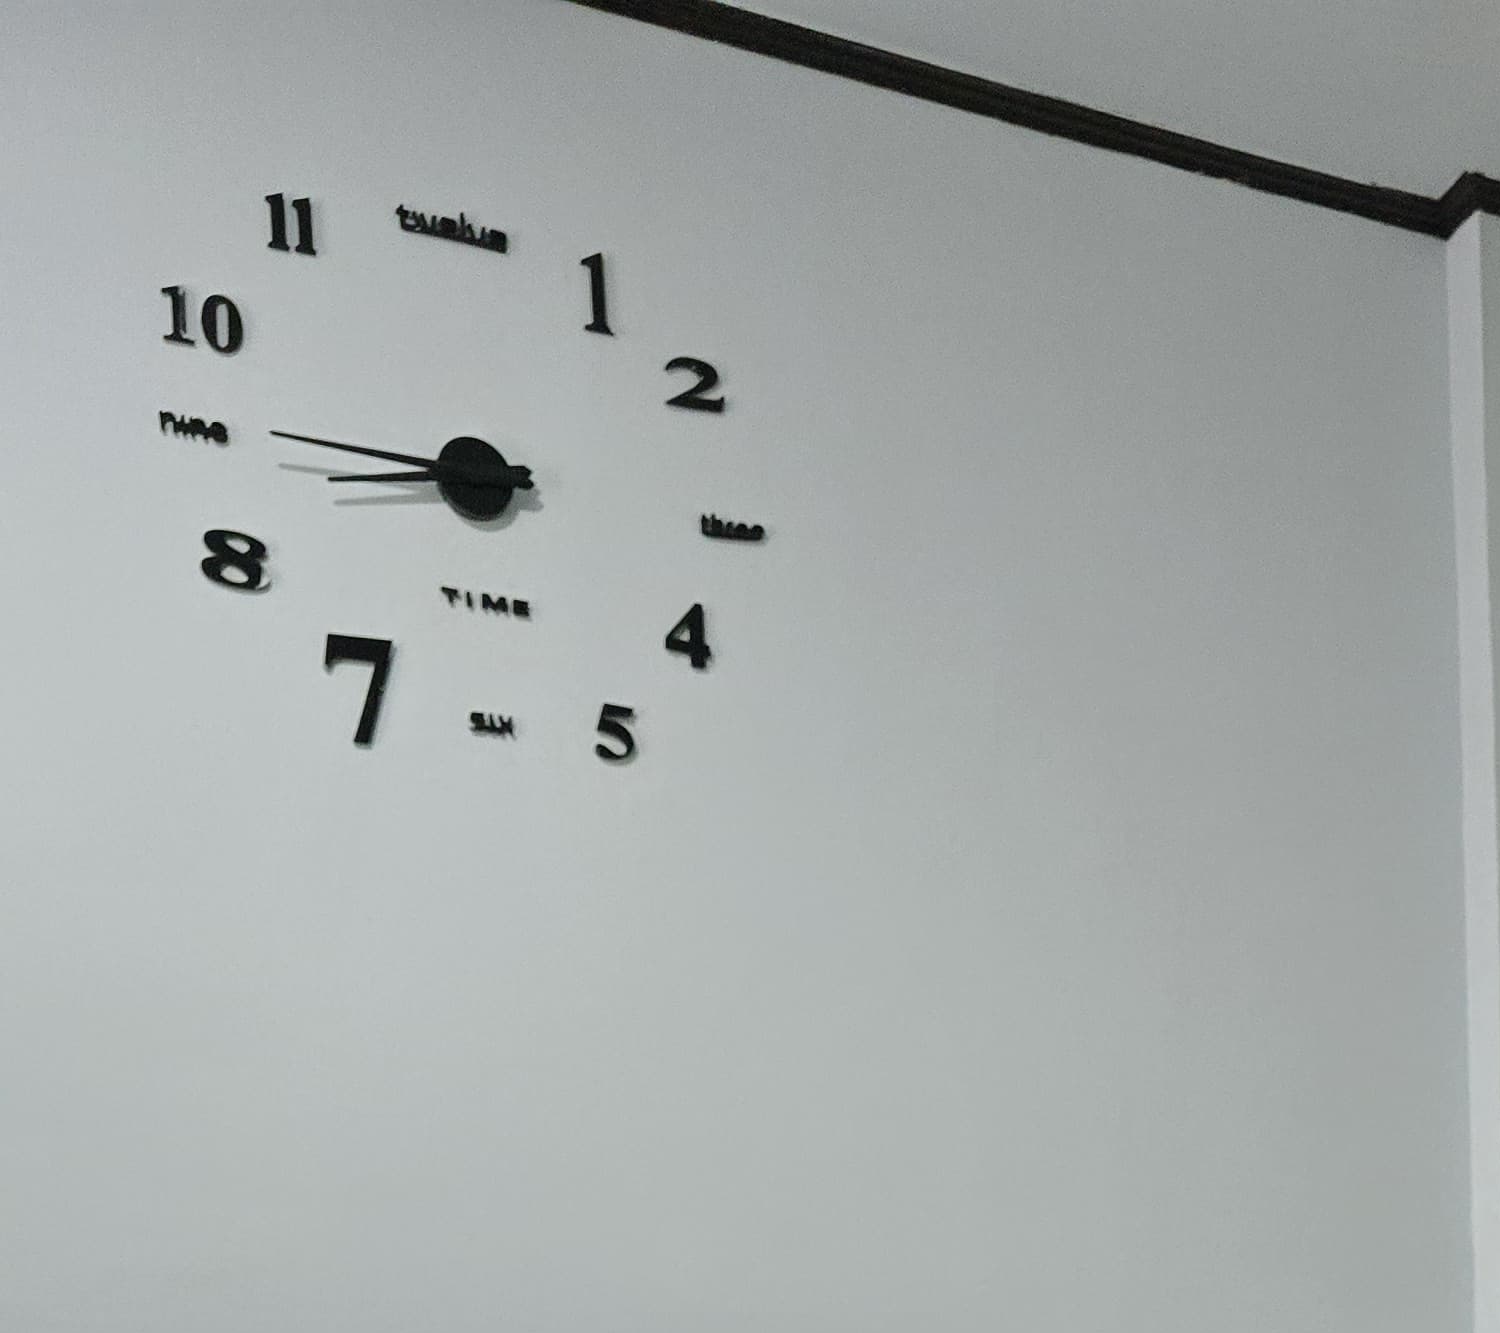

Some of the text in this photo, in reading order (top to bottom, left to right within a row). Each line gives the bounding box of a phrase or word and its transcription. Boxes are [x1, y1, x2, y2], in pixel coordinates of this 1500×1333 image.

[265, 193, 317, 257] 11
[396, 204, 508, 255] twelve
[162, 285, 244, 355] 10
[581, 252, 615, 338] 1
[664, 356, 726, 414] 2
[700, 514, 766, 543] three
[201, 529, 271, 592] 8
[441, 586, 531, 619] TIME
[665, 603, 713, 671] 4
[325, 633, 393, 747] 7
[596, 703, 636, 762] 5
